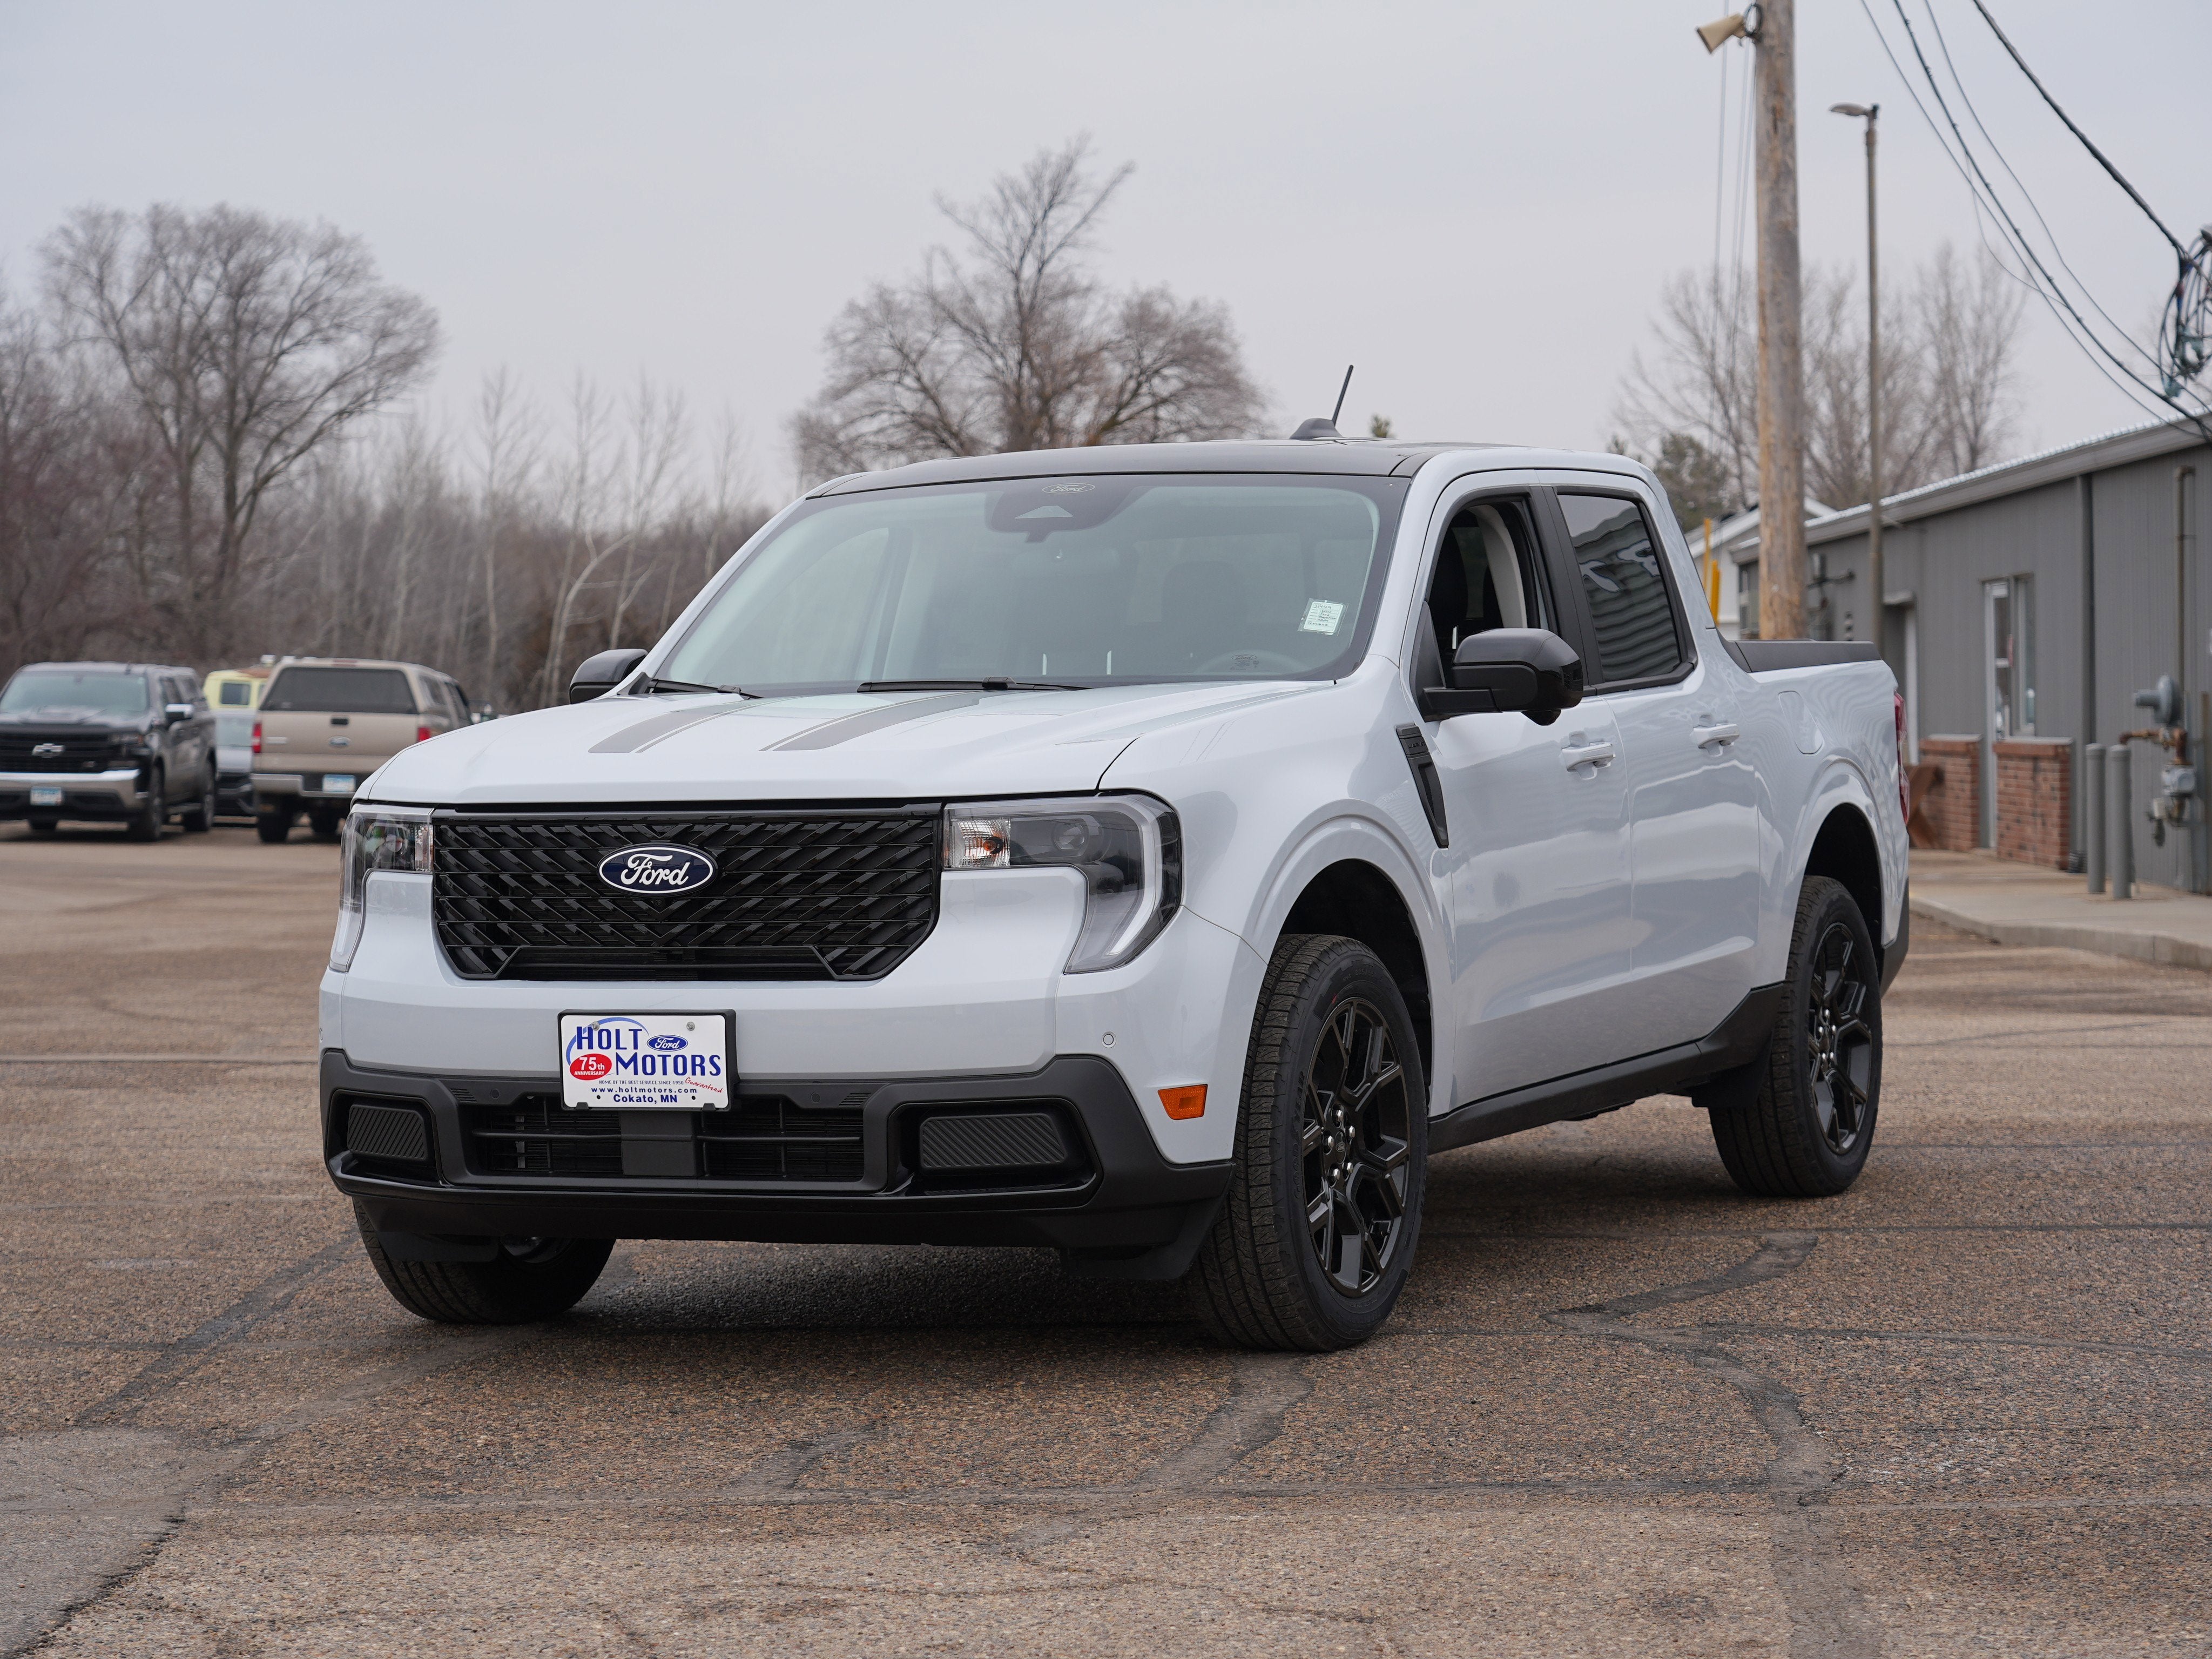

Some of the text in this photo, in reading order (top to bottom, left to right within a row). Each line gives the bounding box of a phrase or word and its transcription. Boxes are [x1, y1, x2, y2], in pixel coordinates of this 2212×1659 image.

[621, 853, 691, 885] Ford
[576, 1026, 643, 1050] HOLT
[655, 1037, 680, 1049] Ford
[579, 1057, 605, 1071] 75th
[616, 1052, 721, 1076] MOTORS
[685, 1077, 723, 1093] Guaranteed
[613, 1094, 678, 1104] Cokato, MN
